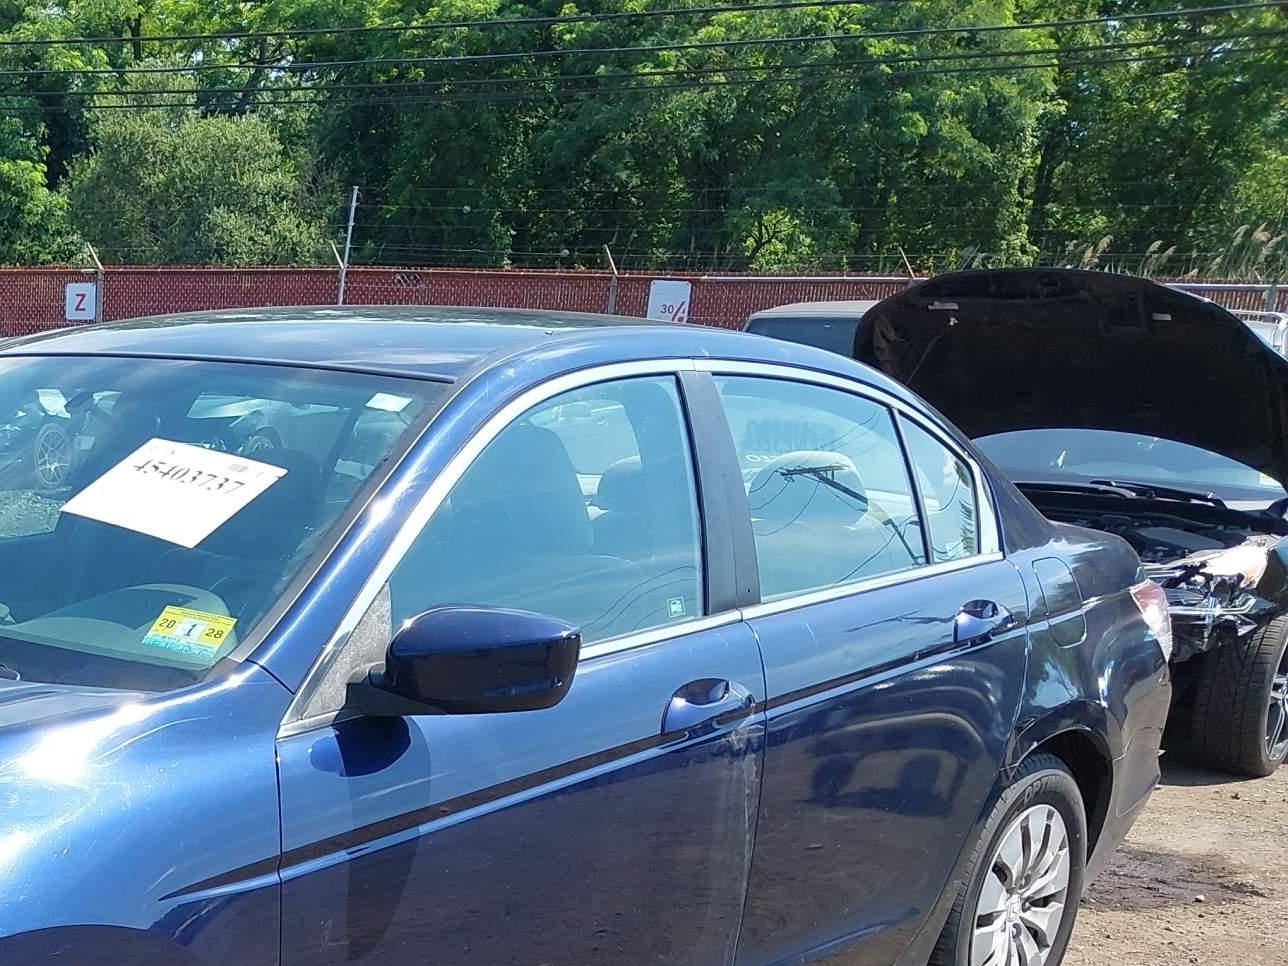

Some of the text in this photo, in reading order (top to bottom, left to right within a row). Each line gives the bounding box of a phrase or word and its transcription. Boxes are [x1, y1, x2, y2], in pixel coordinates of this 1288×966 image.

[75, 293, 87, 311] Z
[132, 459, 246, 494] 45403737
[158, 618, 224, 639] 20 1 28
